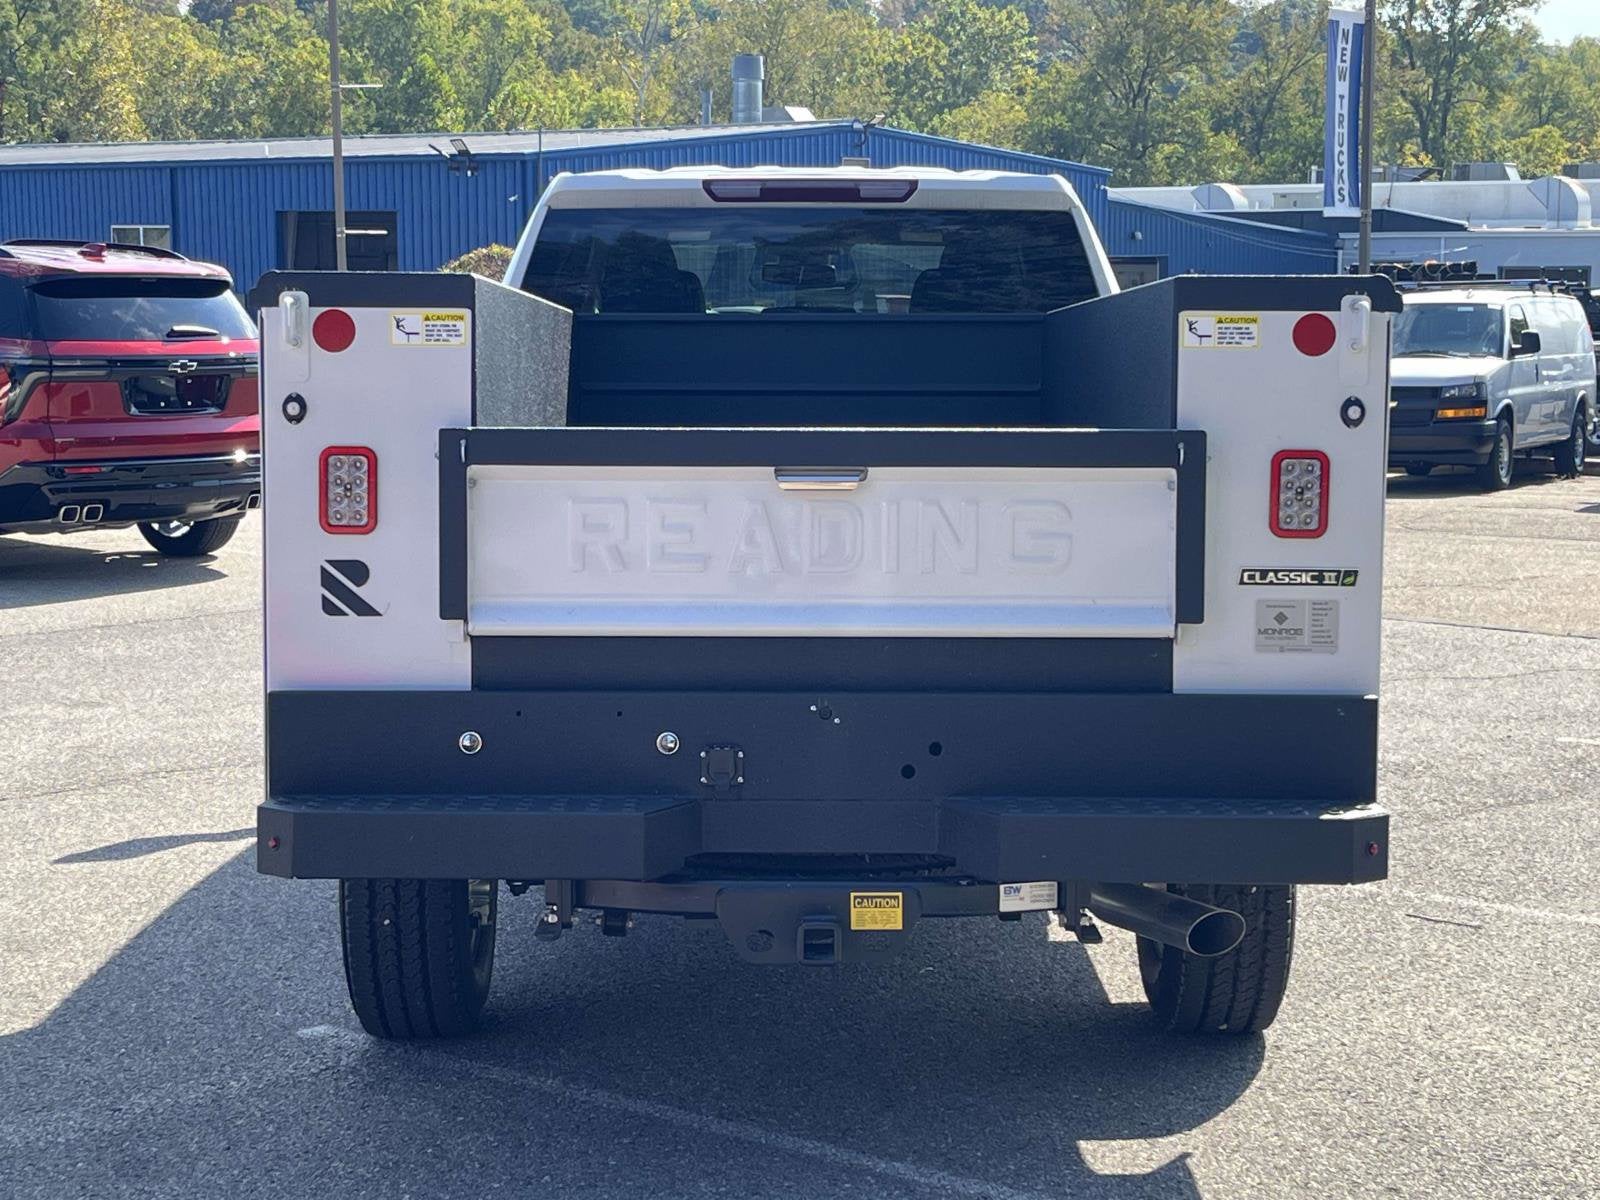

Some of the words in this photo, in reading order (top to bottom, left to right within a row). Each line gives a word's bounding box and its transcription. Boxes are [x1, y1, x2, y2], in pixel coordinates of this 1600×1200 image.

[1337, 28, 1349, 82] NEW
[1337, 94, 1346, 203] TRUCKS
[567, 496, 1074, 576] READING
[1242, 571, 1319, 584] CLASSIC
[1322, 572, 1338, 584] II
[855, 898, 898, 908] CAUTION
